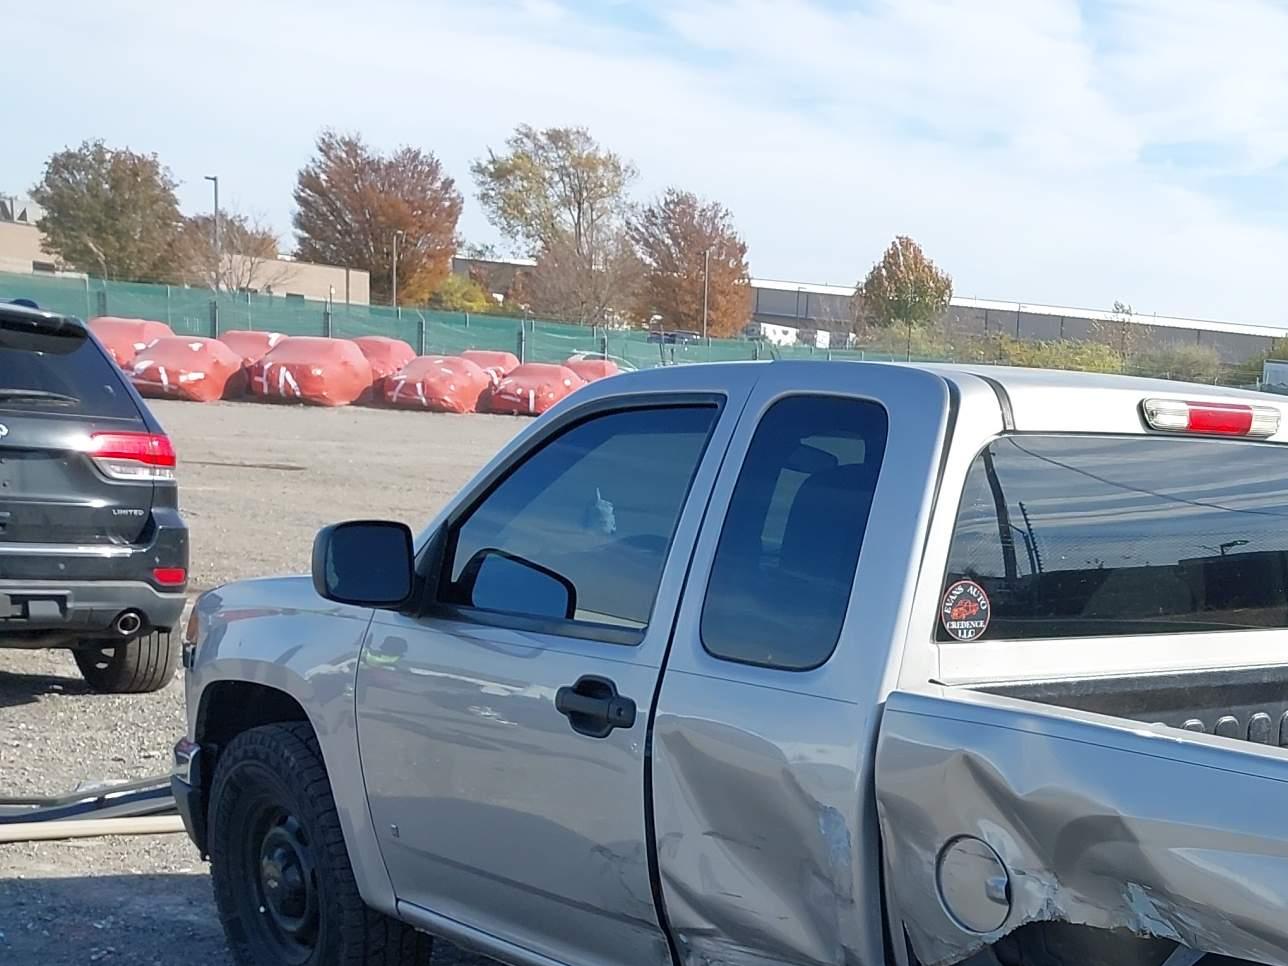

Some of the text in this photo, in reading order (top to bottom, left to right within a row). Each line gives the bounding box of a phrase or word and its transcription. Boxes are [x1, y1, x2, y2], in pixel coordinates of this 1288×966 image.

[944, 585, 988, 614] EVANS AUTO
[946, 621, 985, 629] CREDENCE
[958, 629, 976, 638] LLC
